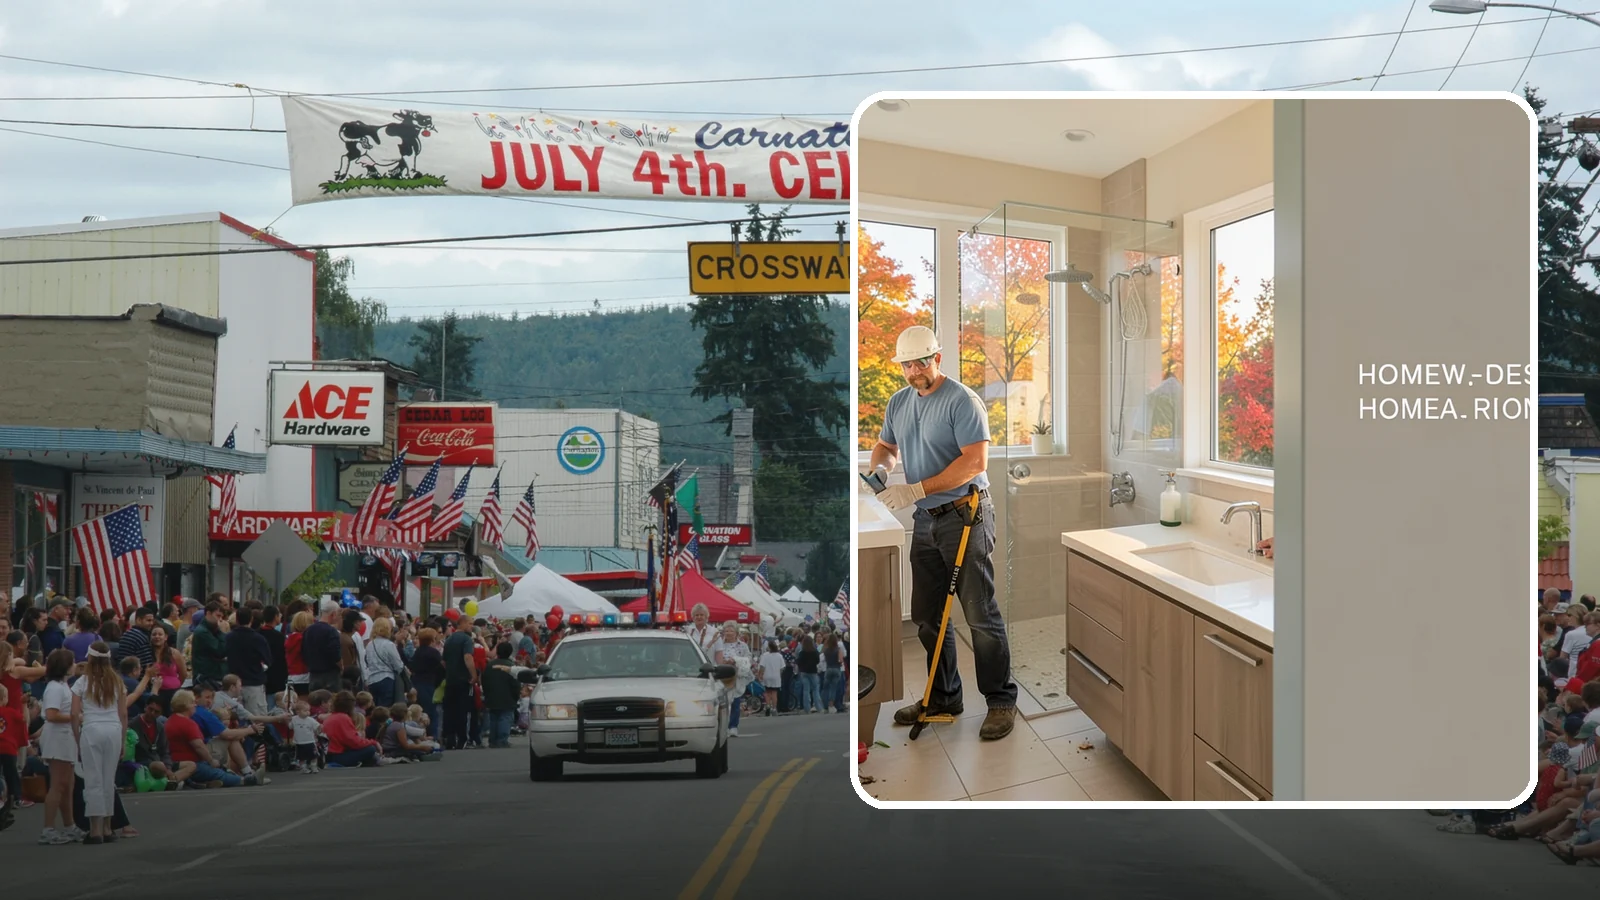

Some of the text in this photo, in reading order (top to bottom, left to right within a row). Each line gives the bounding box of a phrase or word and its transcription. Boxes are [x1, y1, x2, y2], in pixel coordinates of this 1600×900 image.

[695, 122, 850, 149] Carnat
[481, 140, 605, 192] JULY
[632, 149, 746, 197] 4th.
[697, 254, 850, 280] CROSSWA
[283, 380, 373, 419] ACE
[406, 409, 452, 422] CEDAR
[461, 409, 485, 422] LOG
[284, 421, 370, 436] Hardware
[95, 484, 124, 495] Vincent
[126, 485, 136, 495] de
[138, 485, 155, 496] Paul
[688, 526, 741, 535] CRNATION
[699, 535, 730, 543] GLASS
